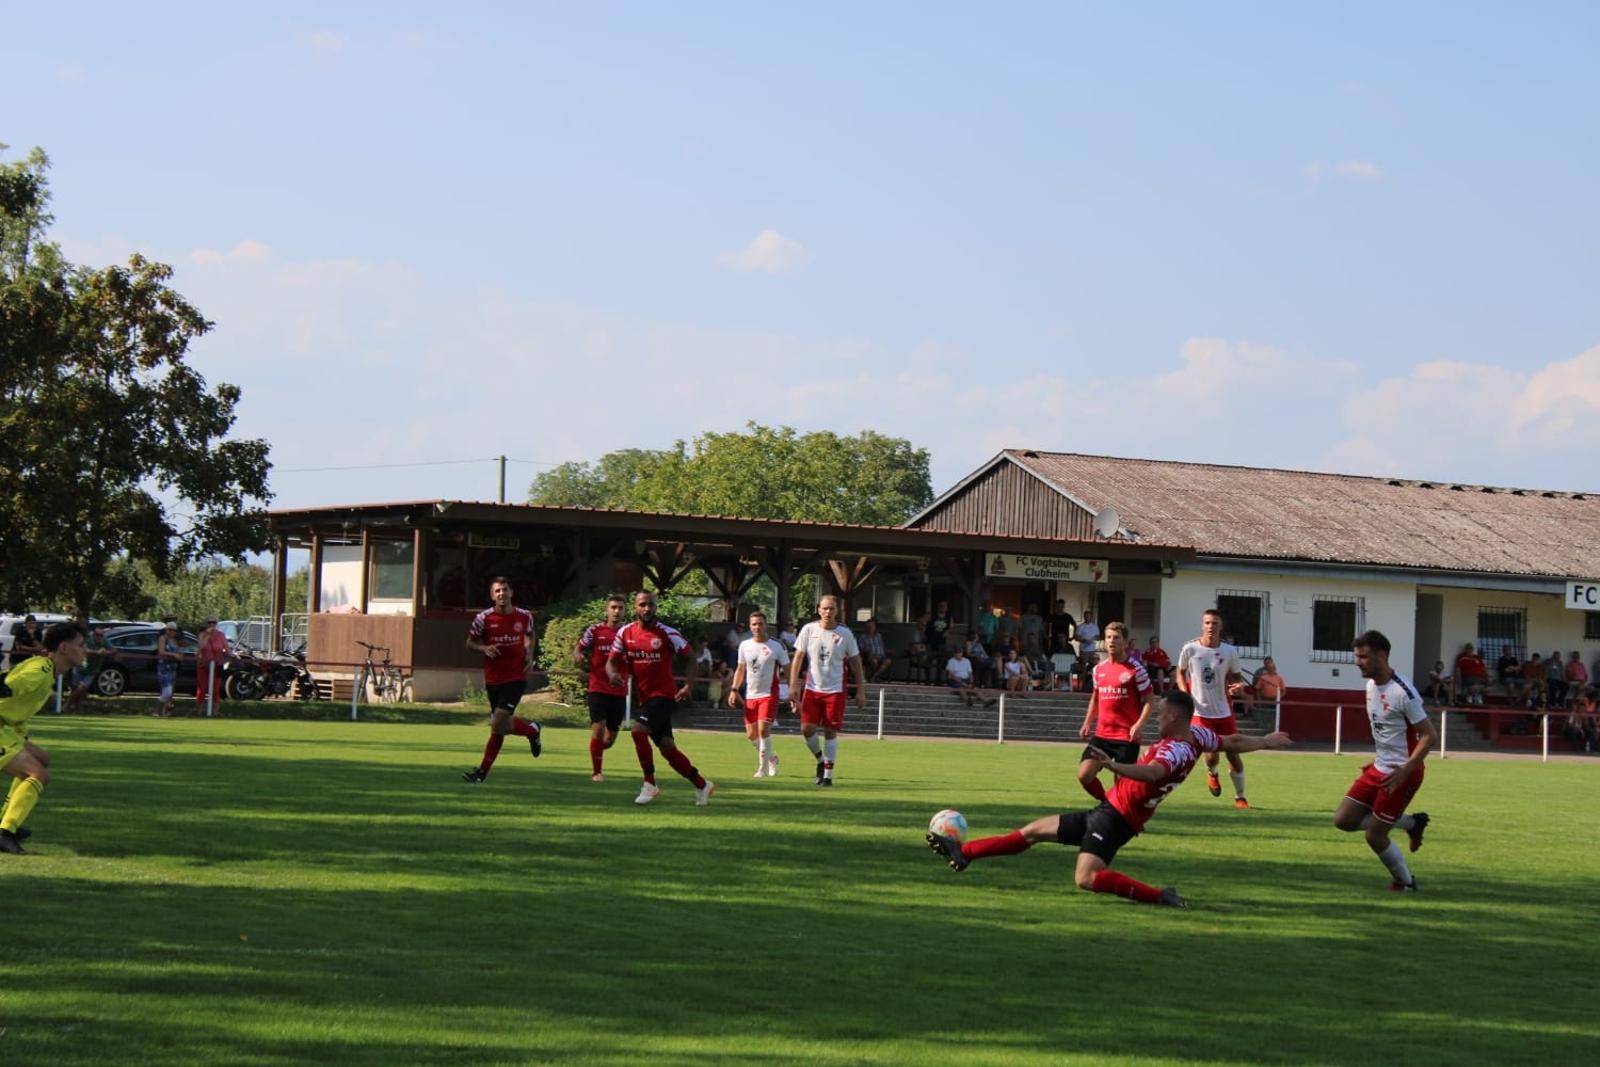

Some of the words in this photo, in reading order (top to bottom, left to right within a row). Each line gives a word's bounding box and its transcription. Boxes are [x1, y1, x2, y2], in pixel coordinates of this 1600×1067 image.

[1016, 556, 1028, 566] FC
[1030, 558, 1080, 571] Vogtsburg
[1025, 567, 1070, 579] Clubheim
[1574, 585, 1597, 605] FC
